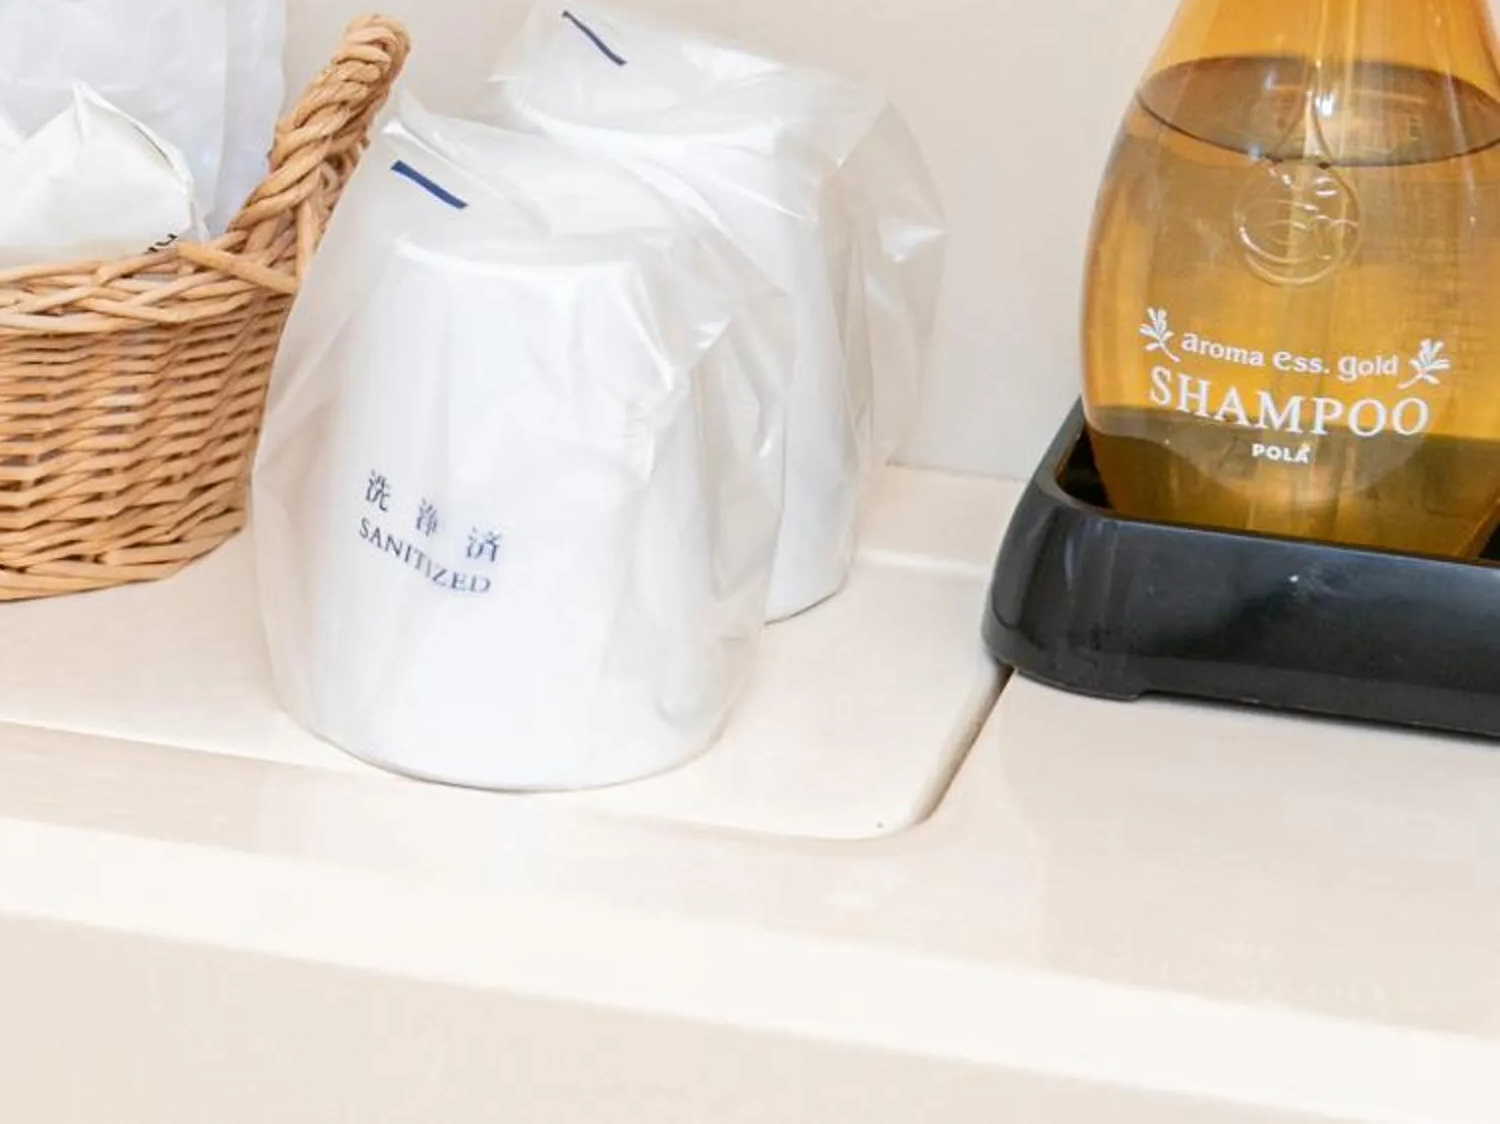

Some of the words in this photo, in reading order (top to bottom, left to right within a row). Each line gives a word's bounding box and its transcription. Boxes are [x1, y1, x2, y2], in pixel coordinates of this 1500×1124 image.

[1180, 331, 1265, 368] aroma
[1272, 349, 1330, 375] ess.
[1337, 354, 1399, 383] gold
[1149, 365, 1430, 438] SHAMPOO
[1251, 442, 1312, 465] POLA
[358, 516, 493, 595] SANITIZED
